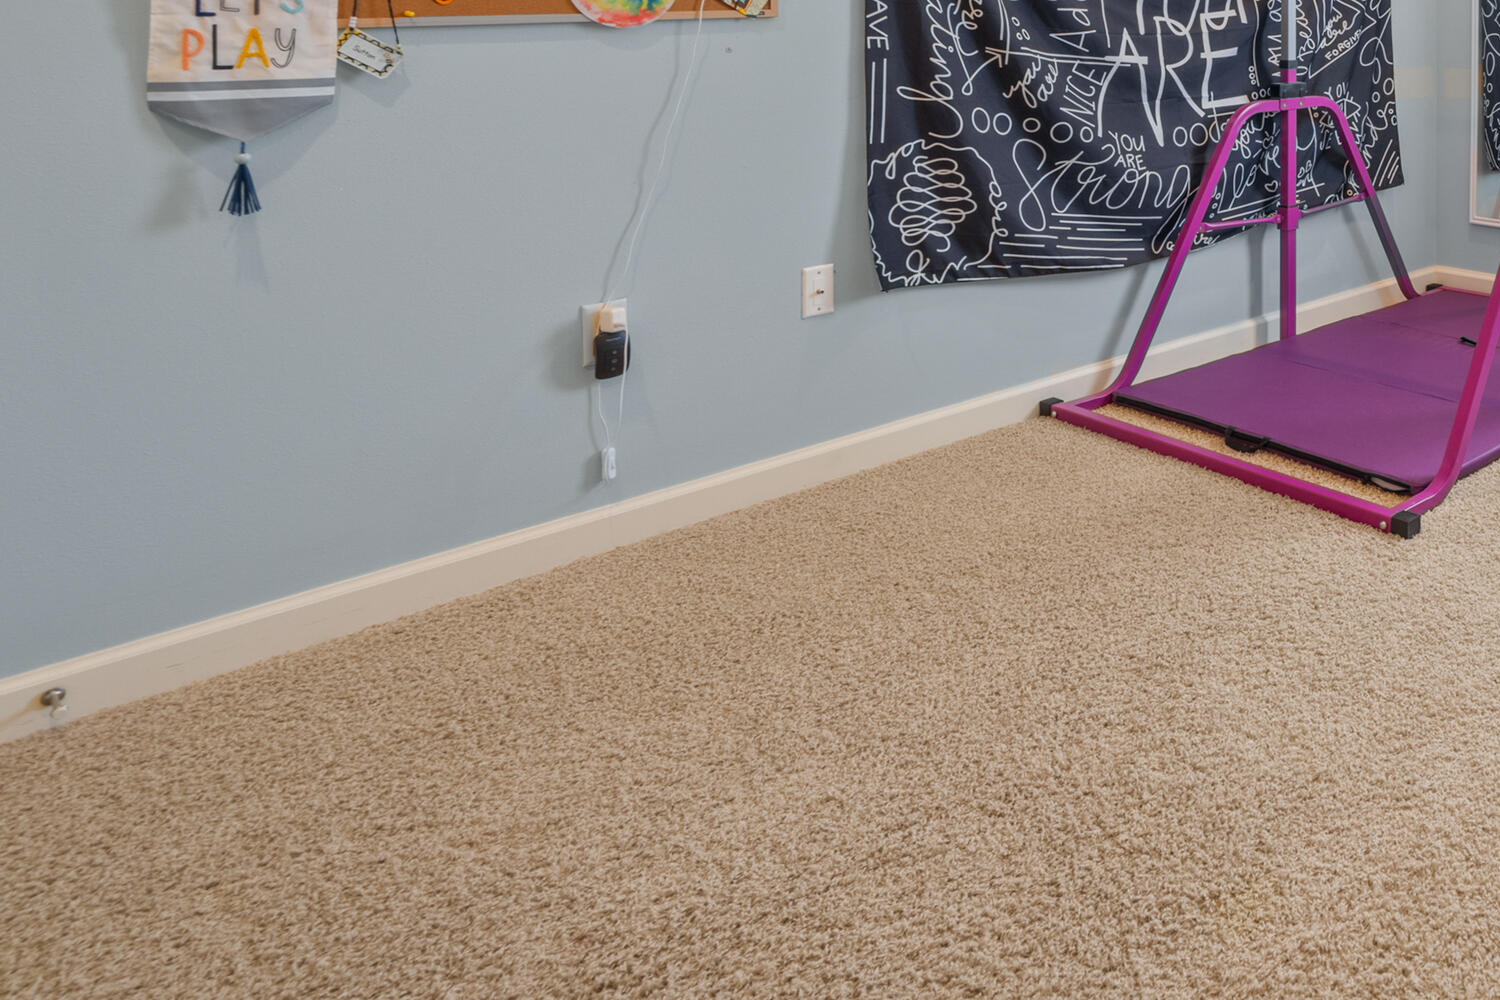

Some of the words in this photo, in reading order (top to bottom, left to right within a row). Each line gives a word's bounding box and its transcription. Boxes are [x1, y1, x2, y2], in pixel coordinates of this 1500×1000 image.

[181, 24, 297, 71] PLAY
[1059, 60, 1108, 127] NICE
[1098, 9, 1249, 147] ARE
[1108, 130, 1146, 155] YOU
[1113, 153, 1148, 171] ARE
